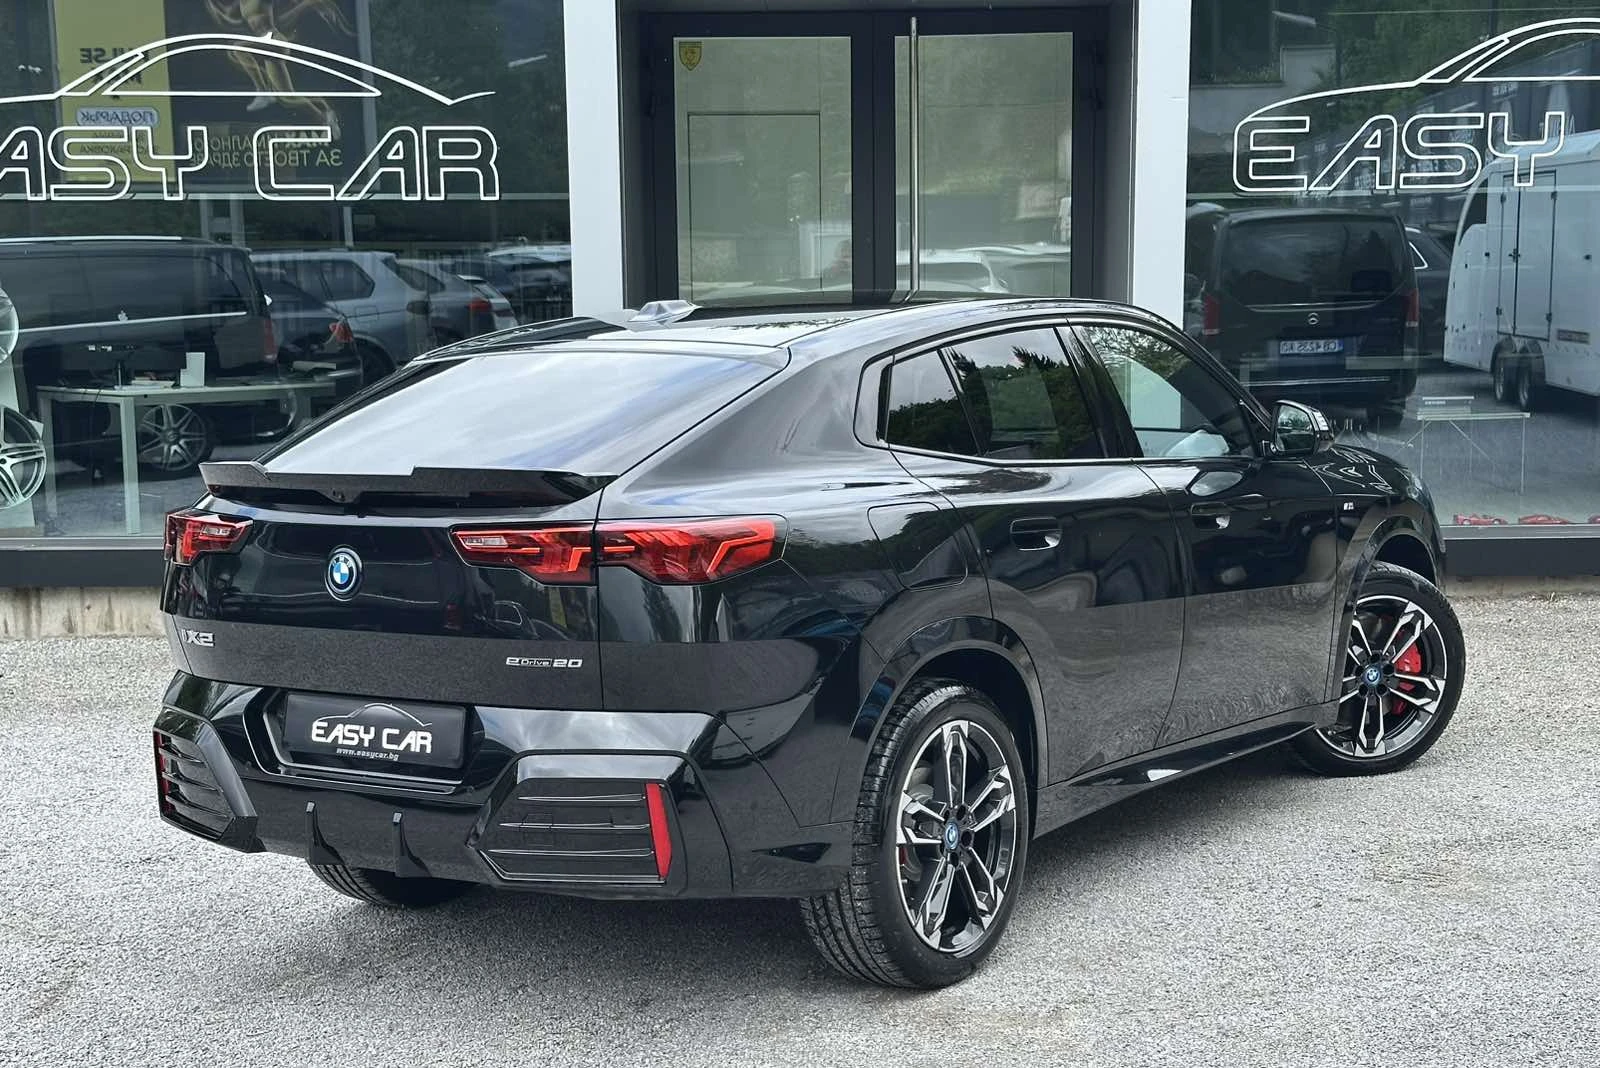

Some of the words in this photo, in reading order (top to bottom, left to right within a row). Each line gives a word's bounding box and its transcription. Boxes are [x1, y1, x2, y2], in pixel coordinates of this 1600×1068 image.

[0, 126, 207, 200] ASY
[254, 126, 499, 200] CAR
[1233, 112, 1565, 191] EASY
[312, 721, 375, 747] EASY
[382, 728, 433, 753] CAR
[336, 748, 399, 761] www.easycar.bg
